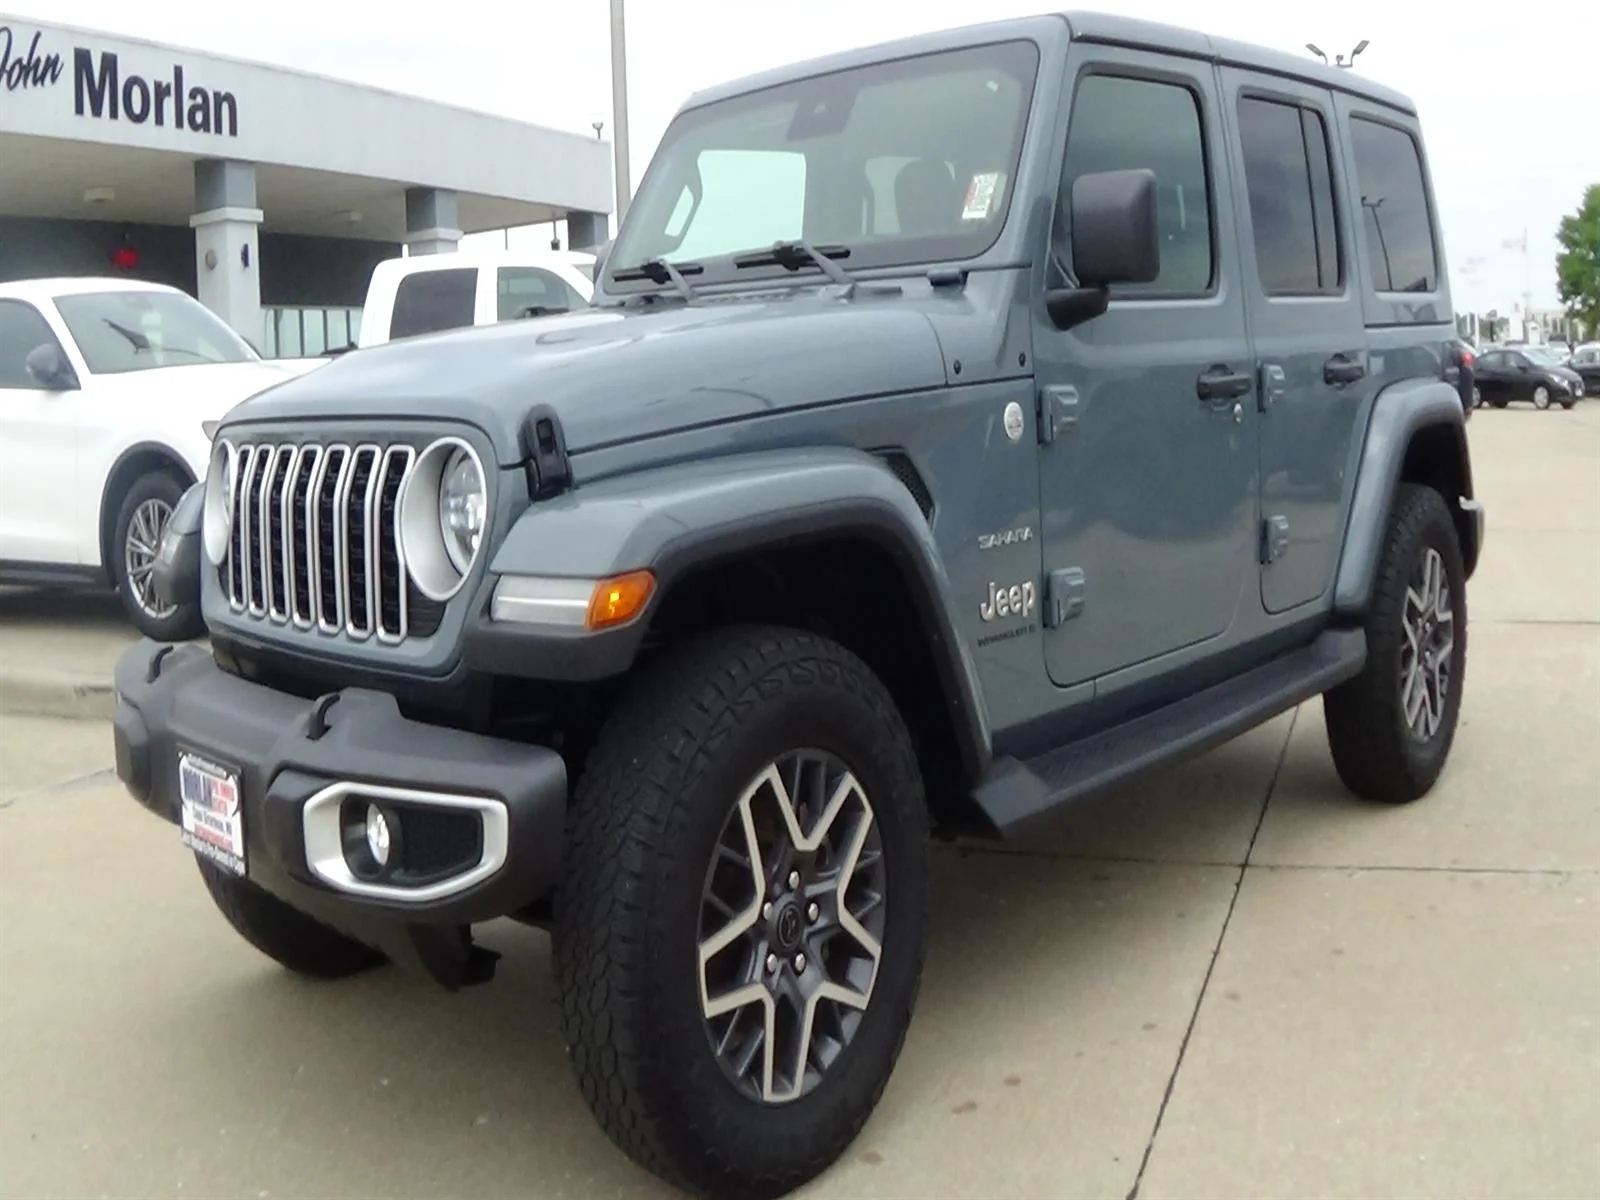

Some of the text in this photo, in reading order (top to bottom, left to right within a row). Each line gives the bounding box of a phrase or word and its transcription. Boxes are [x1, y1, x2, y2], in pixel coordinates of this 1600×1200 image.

[73, 46, 238, 137] Morlan
[978, 526, 1033, 549] SAHARA
[980, 581, 1036, 621] Jeep
